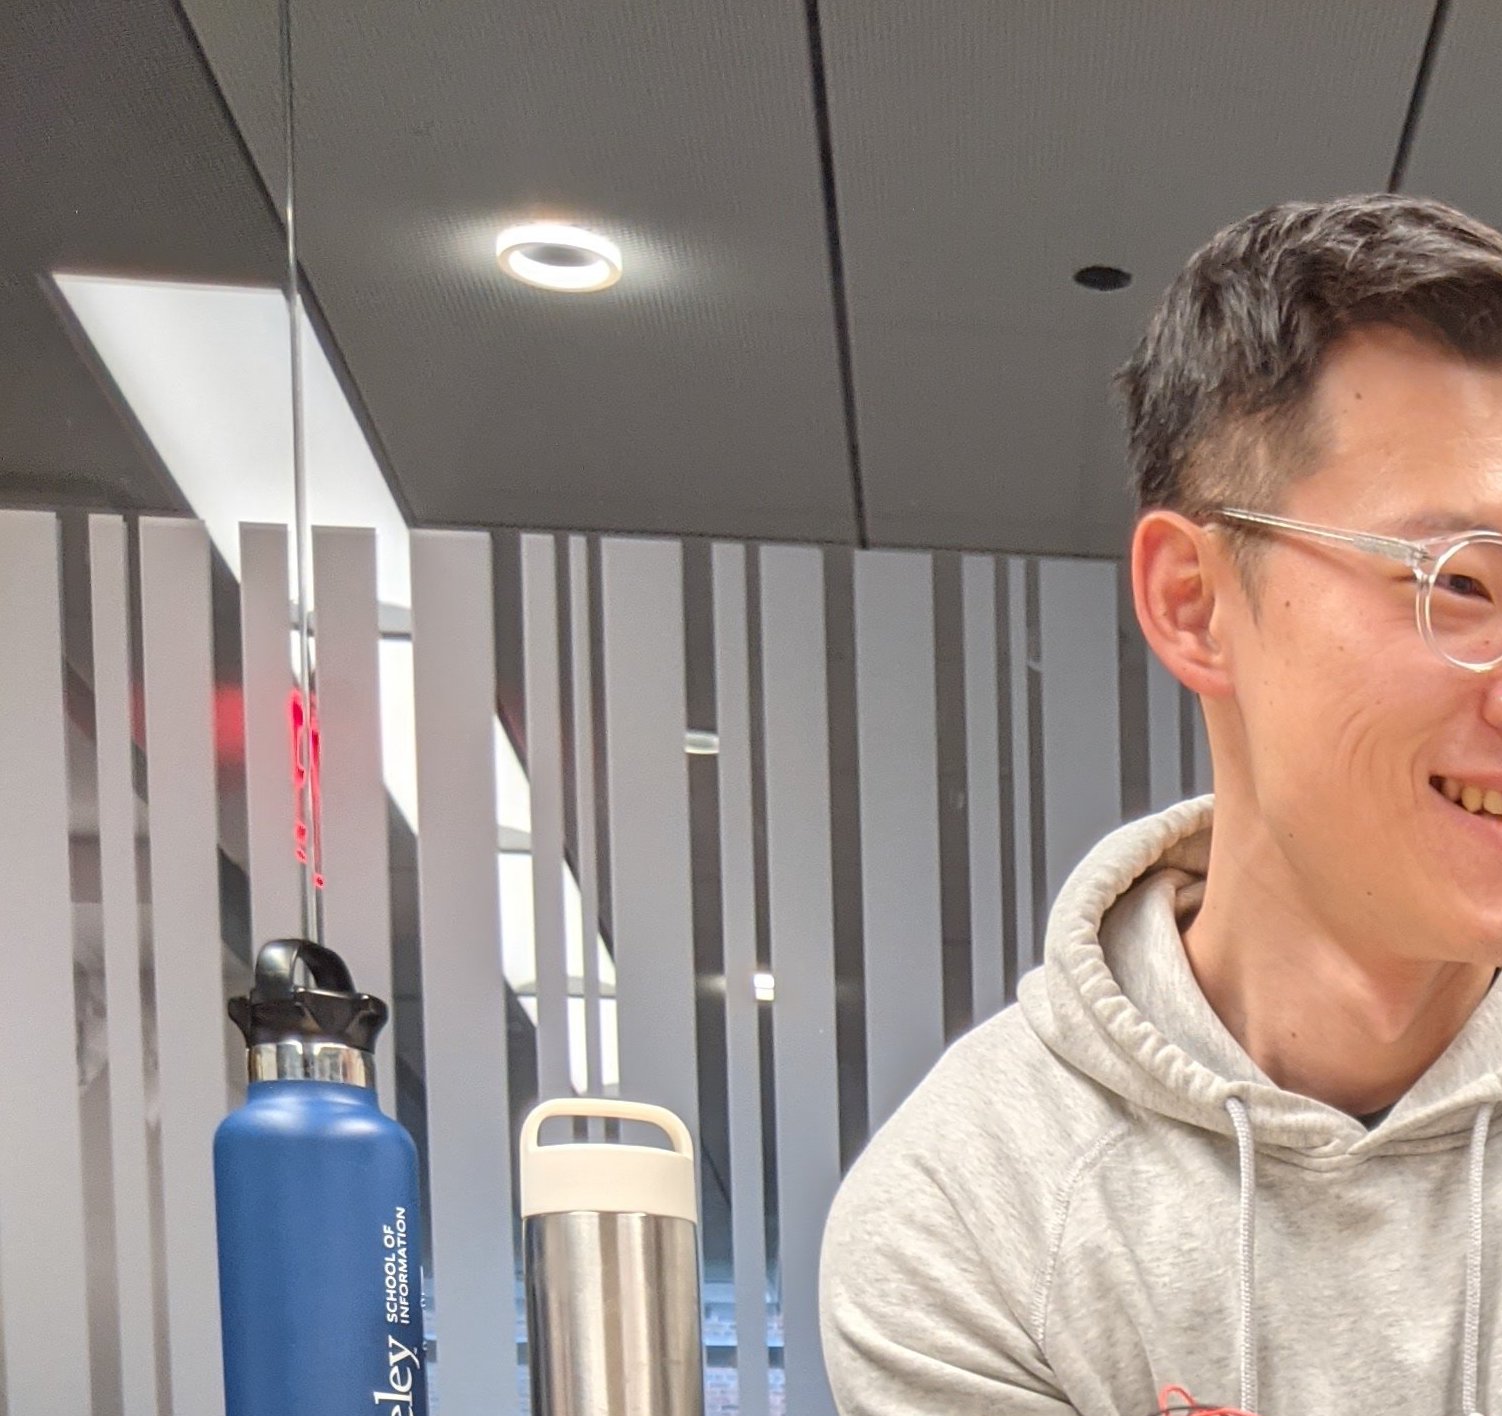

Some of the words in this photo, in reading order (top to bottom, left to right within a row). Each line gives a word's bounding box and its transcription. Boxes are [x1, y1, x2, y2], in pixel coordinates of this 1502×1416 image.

[382, 1223, 396, 1250] OF
[395, 1206, 411, 1325] INFORMATION
[384, 1252, 398, 1324] SCHOOL
